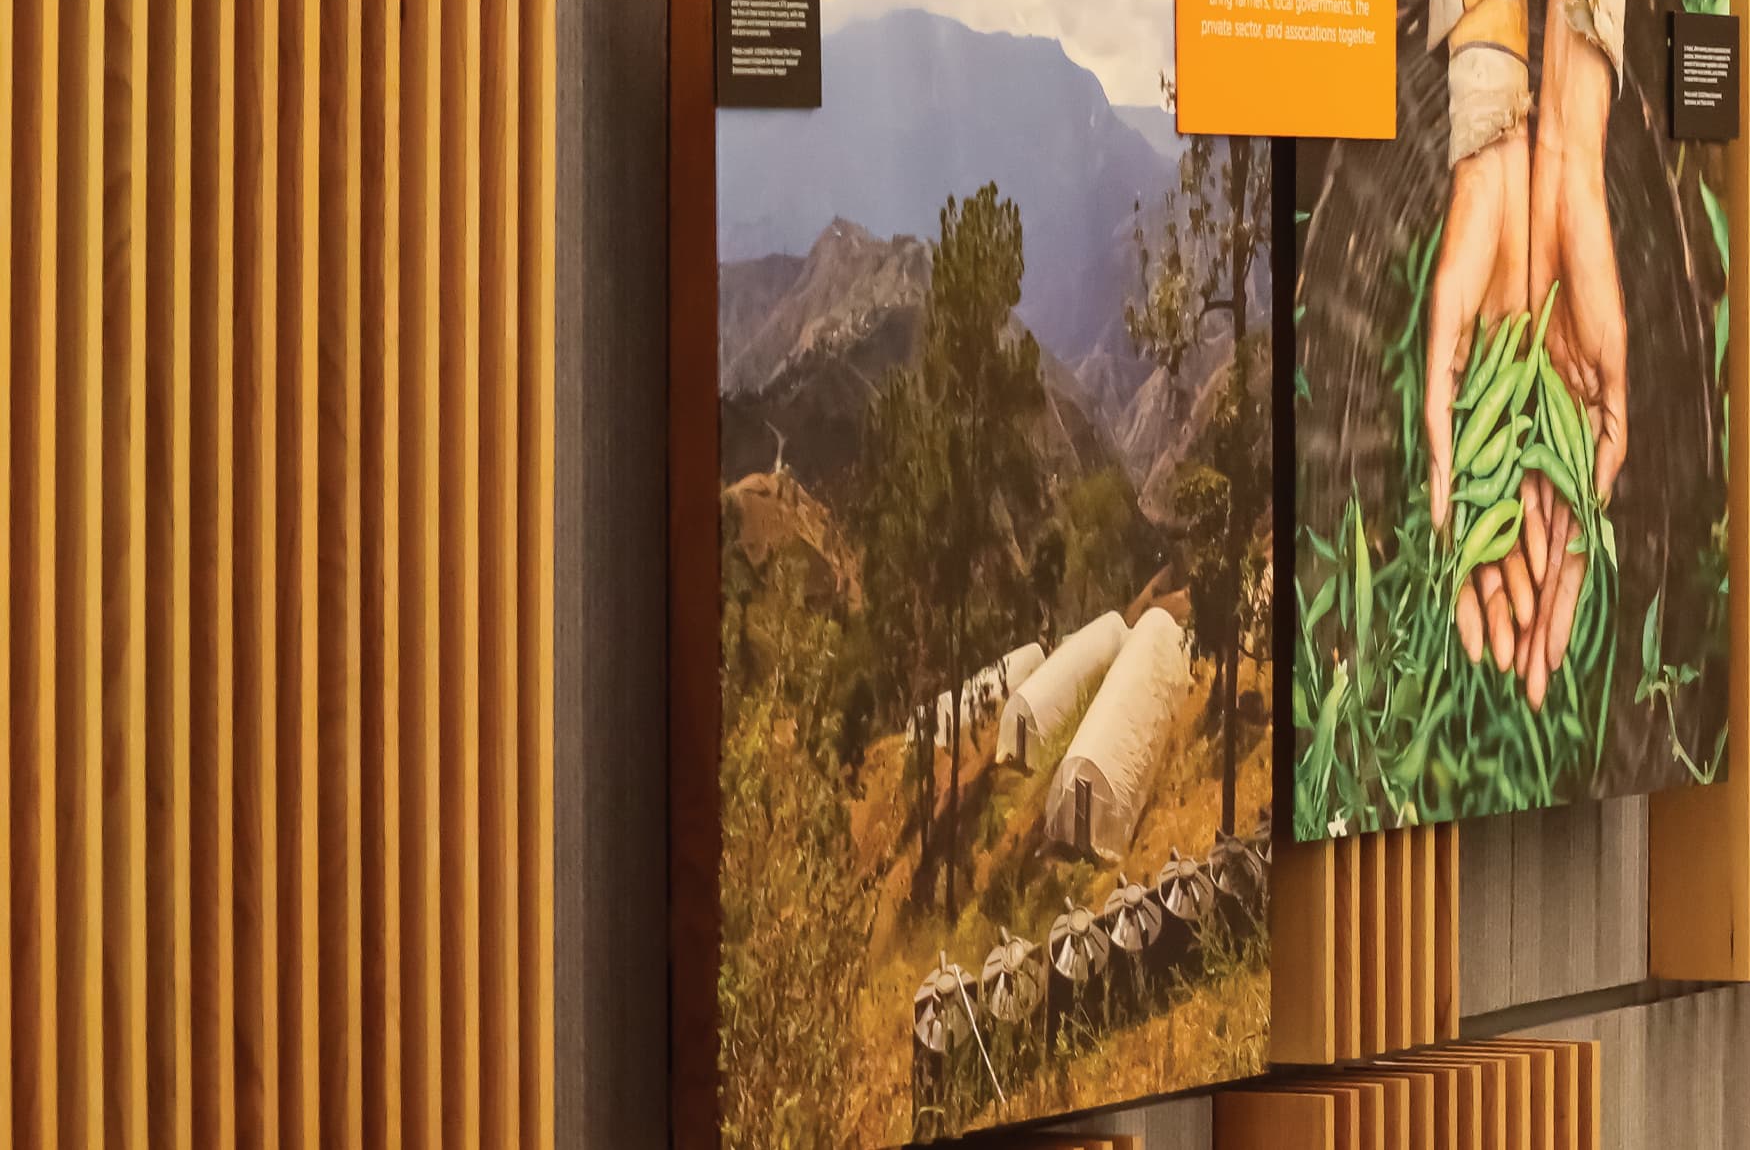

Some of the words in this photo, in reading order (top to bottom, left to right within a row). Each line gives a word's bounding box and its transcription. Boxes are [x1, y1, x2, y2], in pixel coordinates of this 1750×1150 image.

[1201, 19, 1232, 37] private
[1235, 20, 1263, 39] sector,
[1265, 22, 1282, 39] and
[1285, 24, 1336, 43] associations
[1338, 26, 1376, 47] together.
